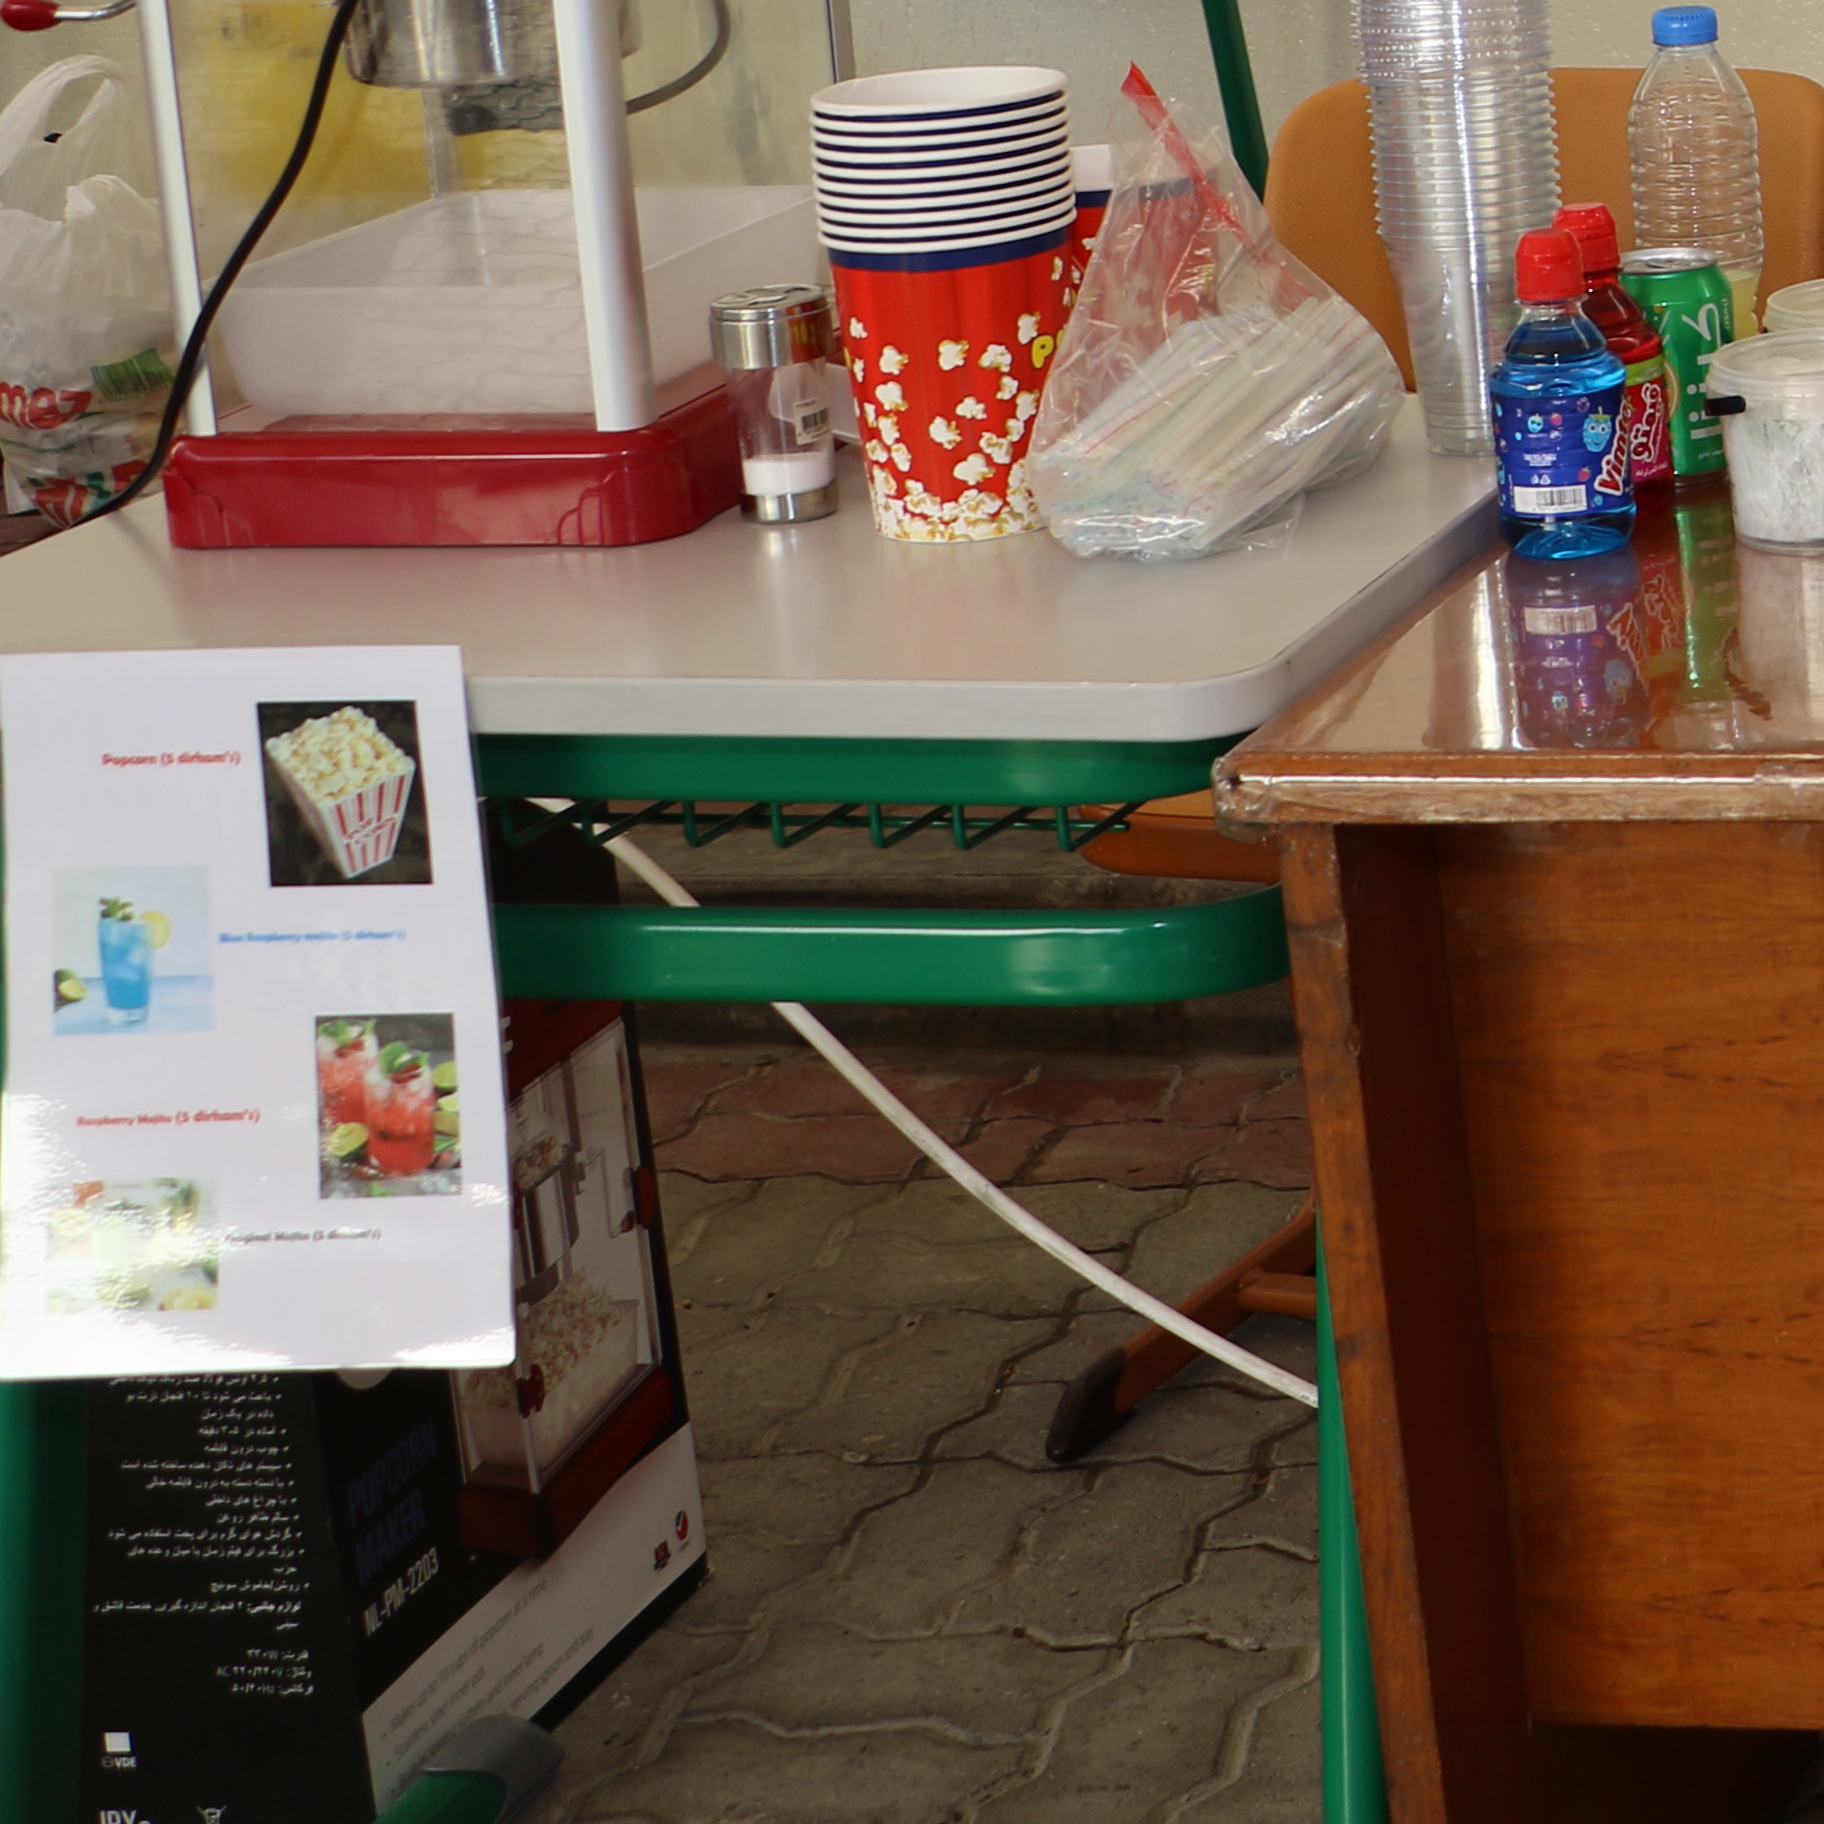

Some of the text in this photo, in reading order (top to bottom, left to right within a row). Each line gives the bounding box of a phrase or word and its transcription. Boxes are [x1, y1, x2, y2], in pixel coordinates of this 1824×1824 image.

[101, 752, 158, 767] Popcorn
[177, 750, 241, 766] dirham's)
[193, 1107, 261, 1125] dirham's)
[347, 1415, 438, 1528] POPCORN
[355, 1489, 425, 1585] MAKER
[364, 1546, 440, 1638] NL-PM-2203
[114, 1756, 137, 1768] VDE
